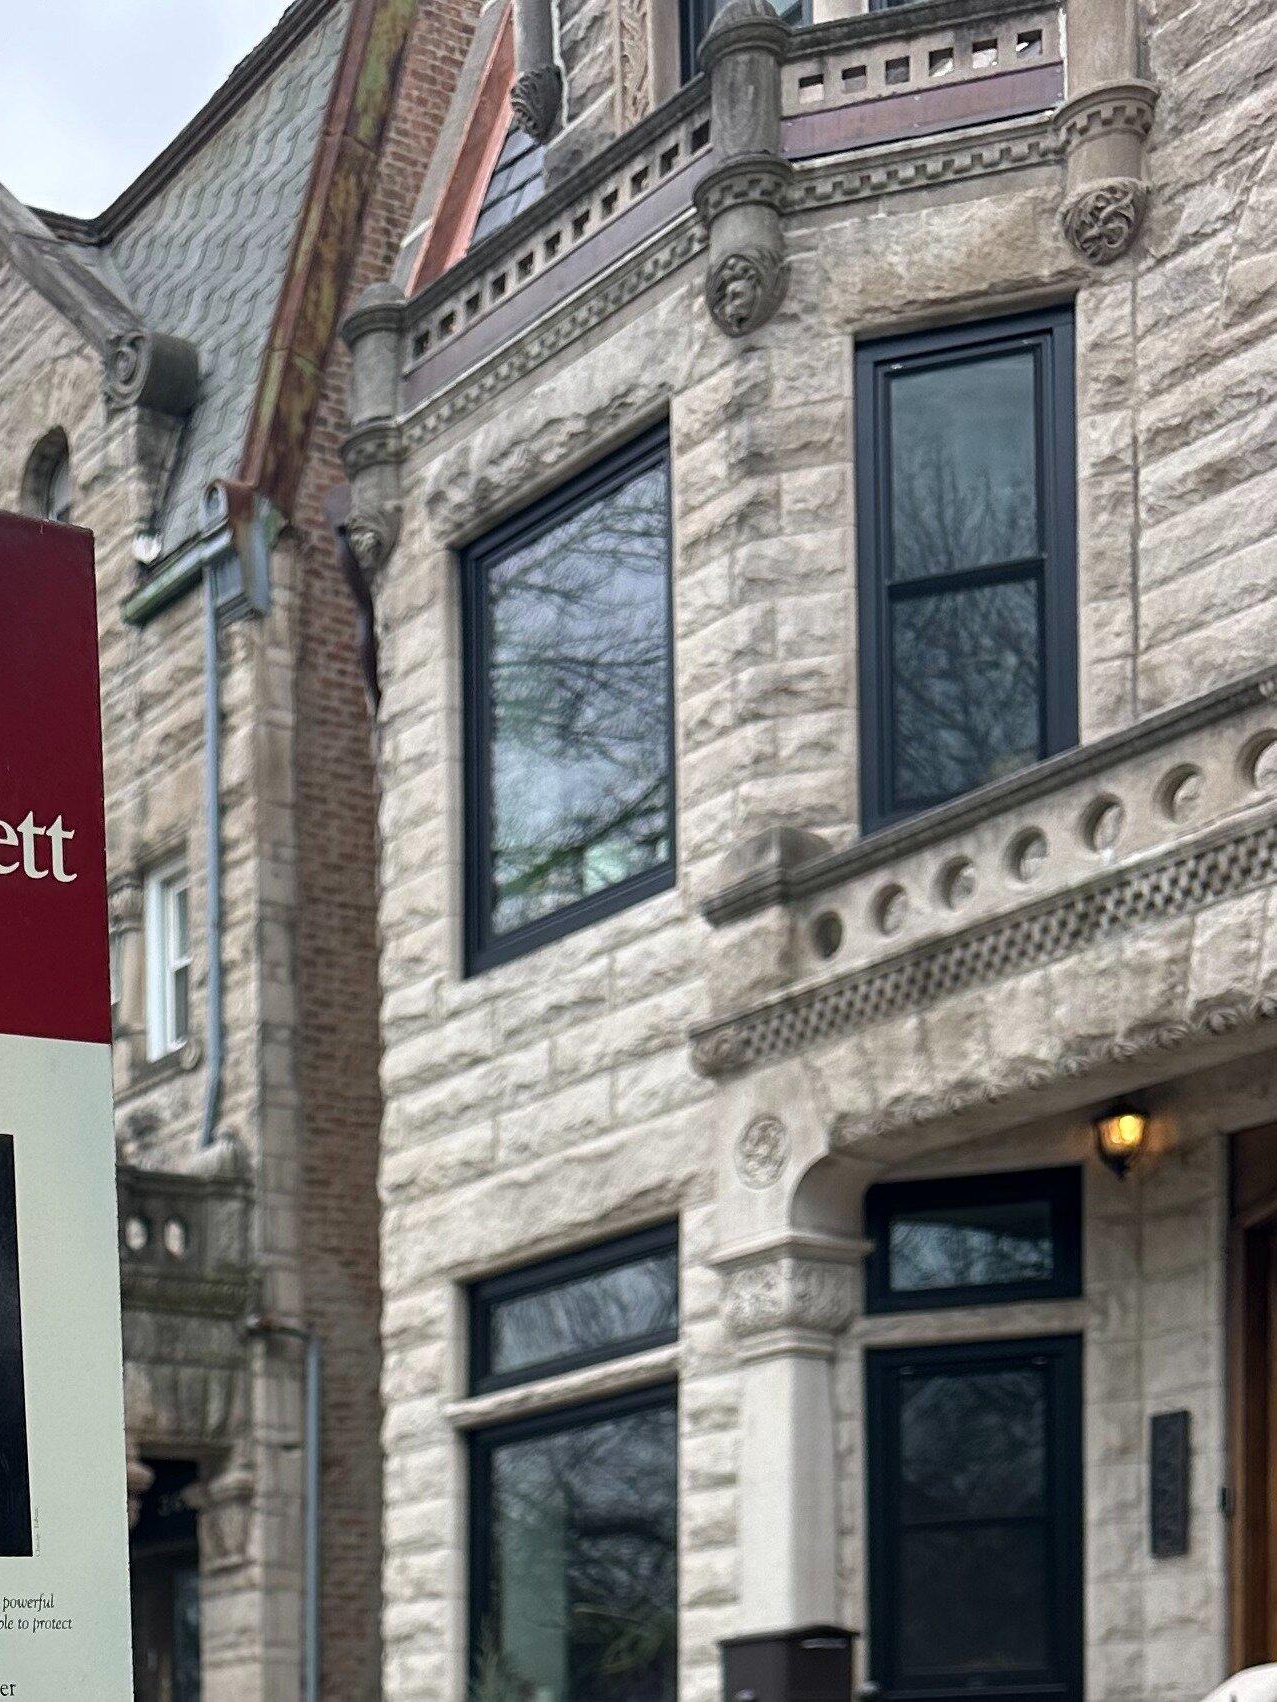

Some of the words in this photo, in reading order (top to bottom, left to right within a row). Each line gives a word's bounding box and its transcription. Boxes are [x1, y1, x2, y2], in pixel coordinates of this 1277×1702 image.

[3, 1593, 55, 1612] powerful
[18, 1618, 29, 1631] to
[32, 1616, 73, 1633] protect
